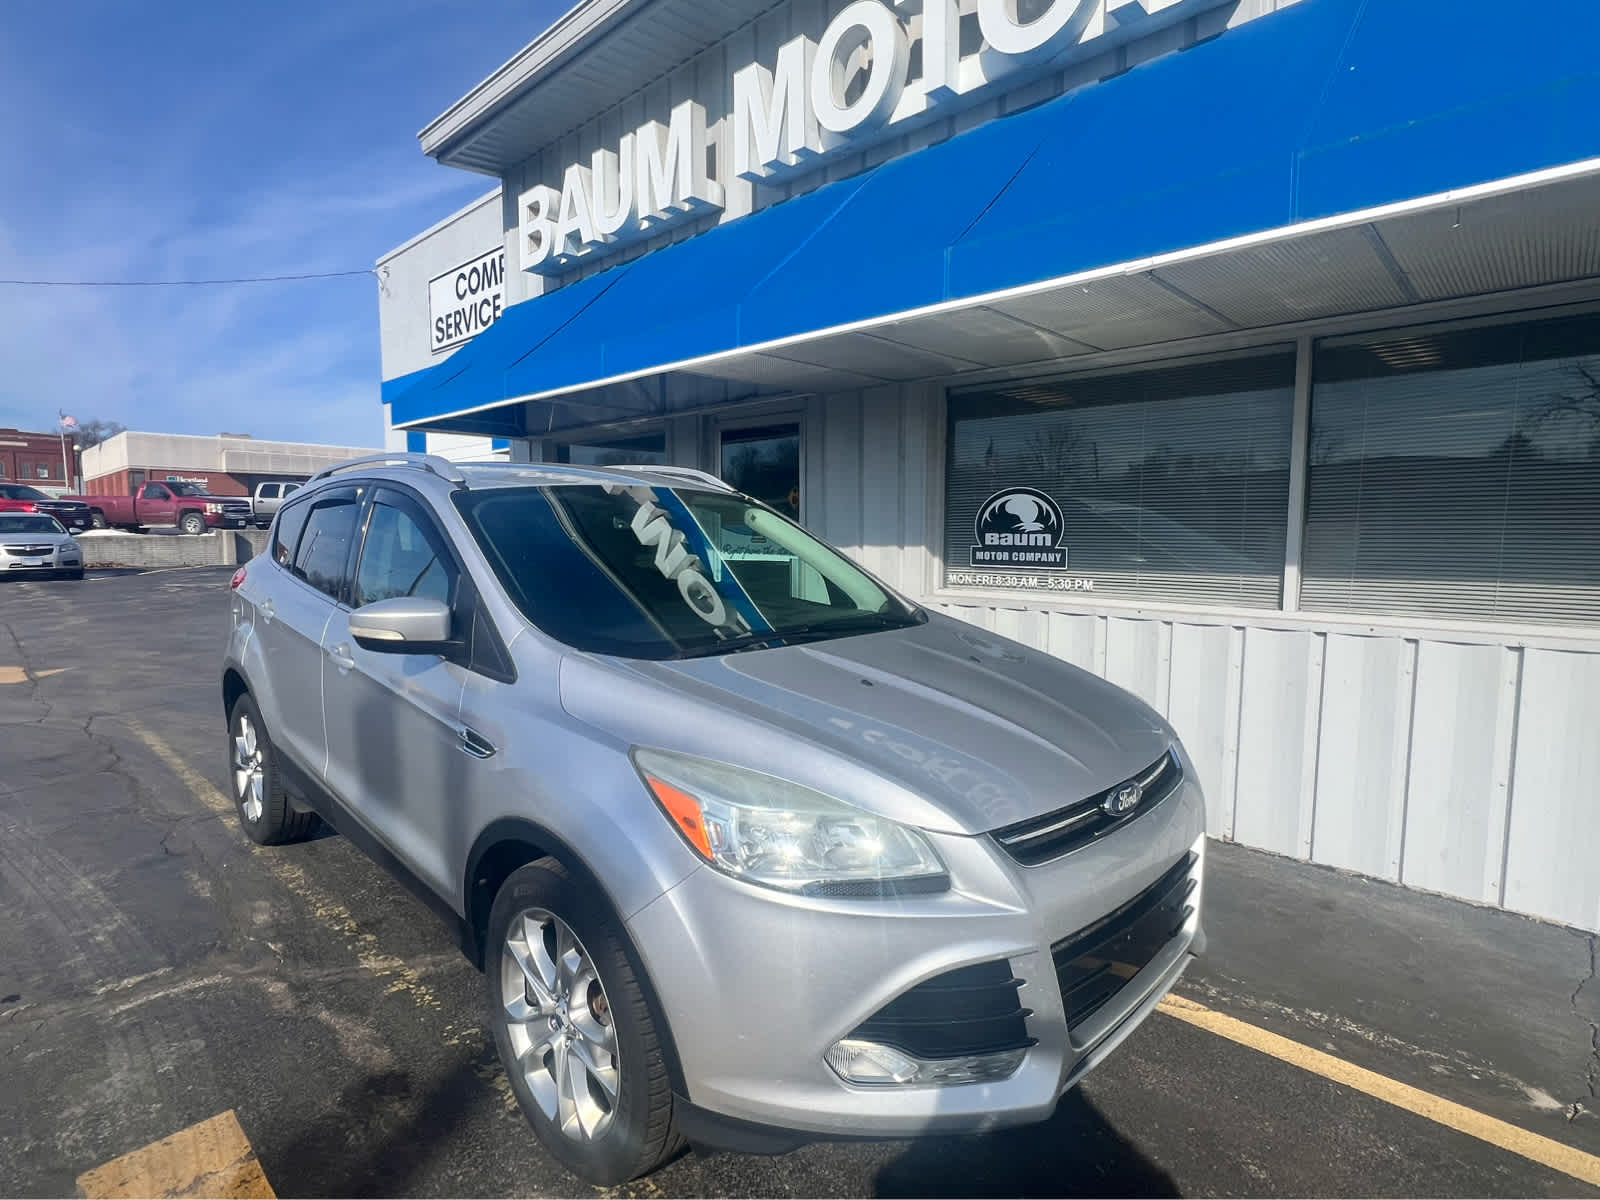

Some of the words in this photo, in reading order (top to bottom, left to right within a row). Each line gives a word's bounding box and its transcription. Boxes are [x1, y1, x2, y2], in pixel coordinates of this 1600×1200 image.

[518, 99, 707, 272] BAUM
[733, 0, 1180, 178] MOT
[435, 293, 502, 343] SERVICE
[984, 532, 1052, 546] Baum
[975, 551, 1009, 561] MOTOR
[1012, 551, 1062, 562] COMPANY
[1019, 576, 1038, 587] AM
[1047, 578, 1071, 590] 5:30
[1074, 579, 1093, 591] PM
[1119, 786, 1137, 811] Ford
